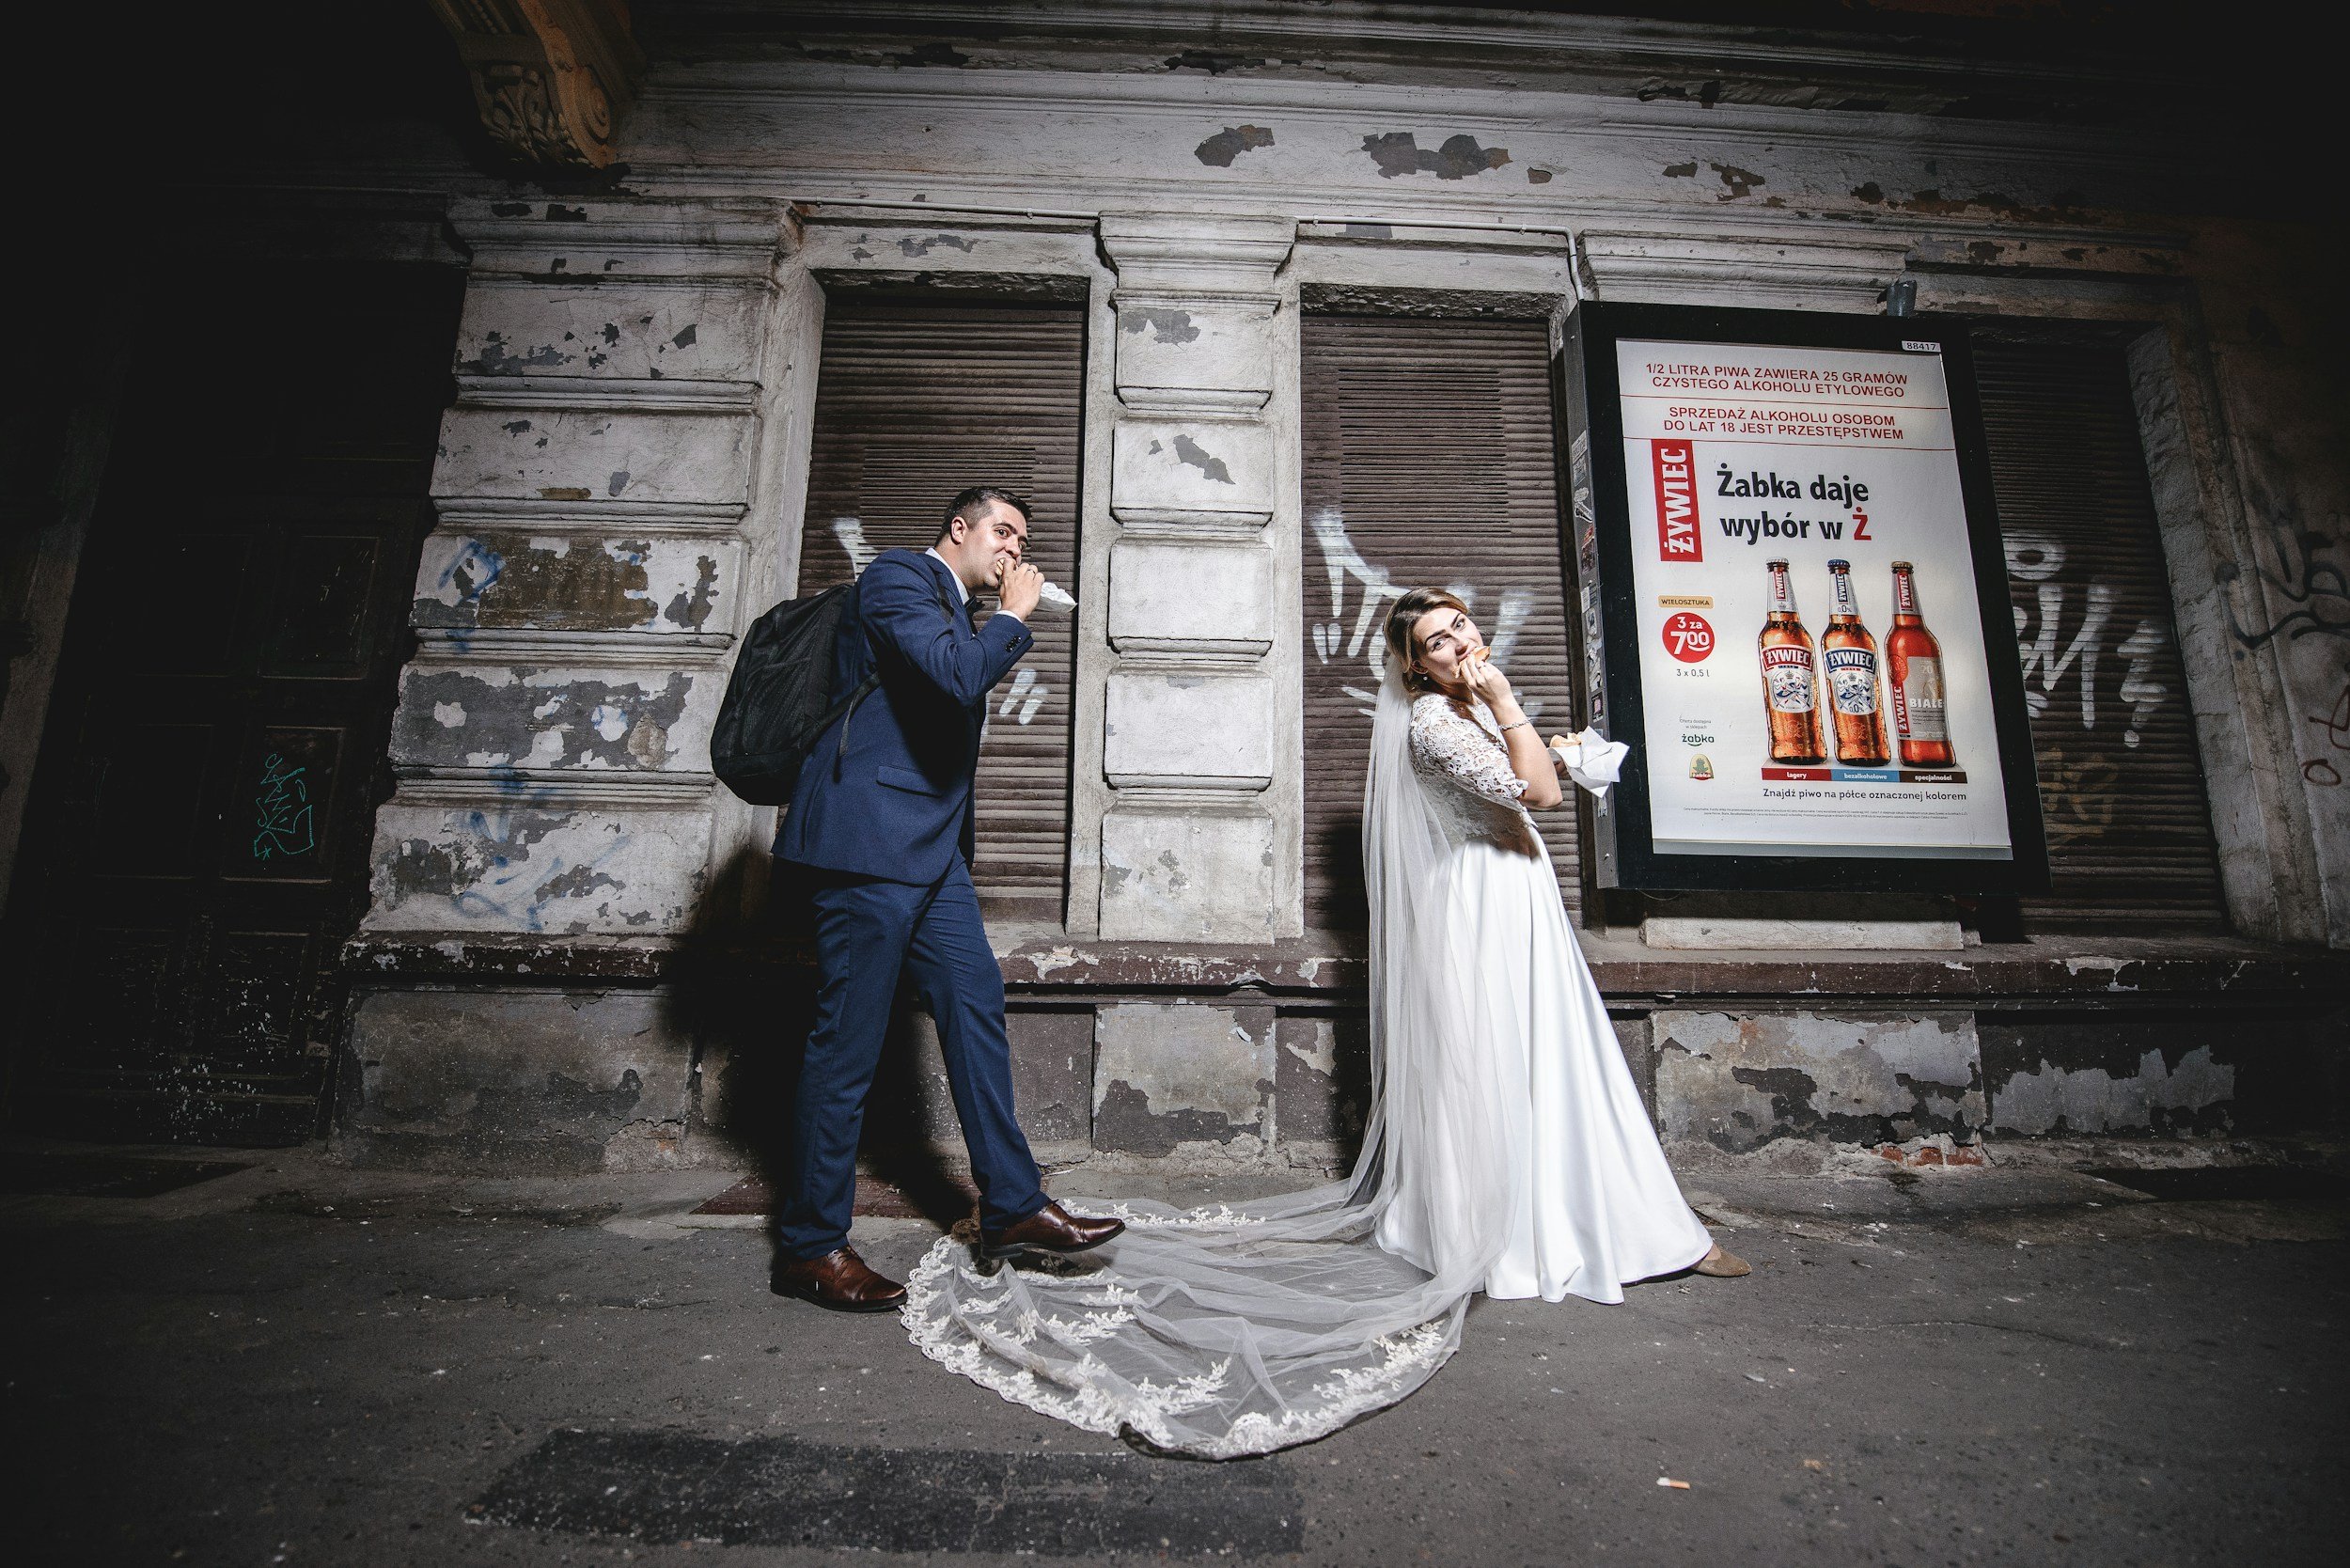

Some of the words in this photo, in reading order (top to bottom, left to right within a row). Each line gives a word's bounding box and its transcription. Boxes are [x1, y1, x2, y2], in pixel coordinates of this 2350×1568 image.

[1906, 342, 1936, 351] 88417
[1646, 363, 1665, 374] 1/2
[1668, 364, 1710, 376] LITRA
[1715, 366, 1750, 378] PIWA
[1754, 368, 1819, 381] ZAWIERA
[1824, 371, 1838, 382] 25
[1842, 371, 1907, 384] GRAMÓW
[1653, 377, 1729, 390] CZYSTEGO
[1733, 380, 1810, 393] ALKOHOLU
[1816, 384, 1904, 397] ETYLOWEGO
[1669, 407, 1747, 420] SPRZEDAŻ
[1750, 411, 1827, 423] ALKOHOLU
[1833, 414, 1895, 426] OSOBOM
[1664, 420, 1684, 431] DO
[1690, 421, 1716, 431] LAT
[1721, 423, 1735, 432] 18
[1740, 423, 1774, 434] JEST
[1778, 425, 1904, 440] PRZESTĘPSTWEM
[1716, 463, 1802, 499] Żabka
[1810, 475, 1870, 510] daje
[1660, 447, 1695, 554] ŻYWIEC
[1719, 510, 1810, 546] wybór
[1818, 521, 1842, 540] w
[1852, 506, 1872, 541] Ż
[1900, 574, 1912, 607] ŻYWIEC
[1677, 616, 1686, 629] 3
[1766, 649, 1810, 666] ŻYWIEC
[1829, 651, 1872, 668] ŻYWIEC
[1676, 668, 1682, 677] 3
[1893, 685, 1907, 730] ŻYWIEC
[1682, 733, 1715, 743] żabka
[1787, 772, 1807, 780] lagery
[1762, 788, 1796, 799] Znajdź
[1798, 790, 1822, 799] piwo
[1839, 790, 1866, 801] półce
[1869, 792, 1923, 802] oznaczonej
[1925, 791, 1966, 800] kolorem
